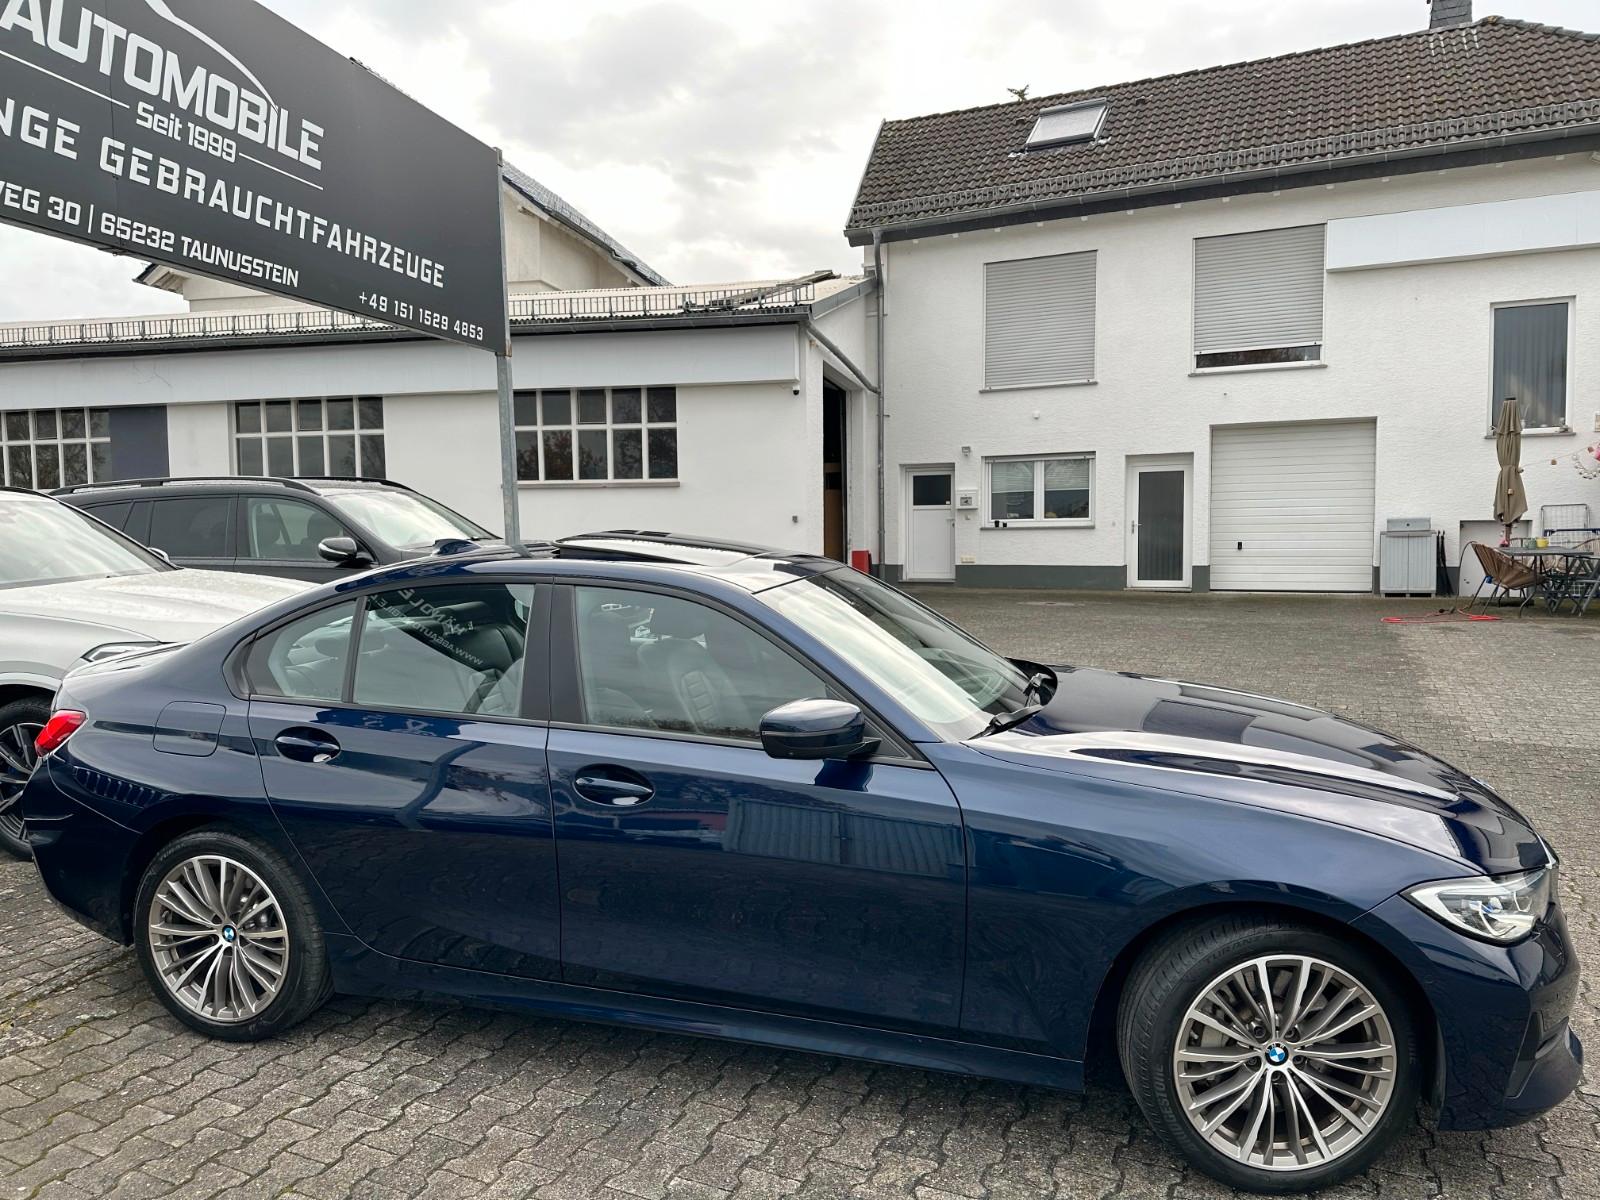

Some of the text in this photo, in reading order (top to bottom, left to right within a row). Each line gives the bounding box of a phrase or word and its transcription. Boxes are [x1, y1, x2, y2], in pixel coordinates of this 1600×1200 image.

[0, 0, 324, 171] AUTOMOBILE
[136, 101, 237, 163] Seit 1999
[0, 180, 299, 288] EG 30 65232 TAUNUSSTEIN
[100, 136, 445, 288] GEBRAUCHTFAHRZEUGE
[359, 291, 484, 341] +49 151 1529 4853
